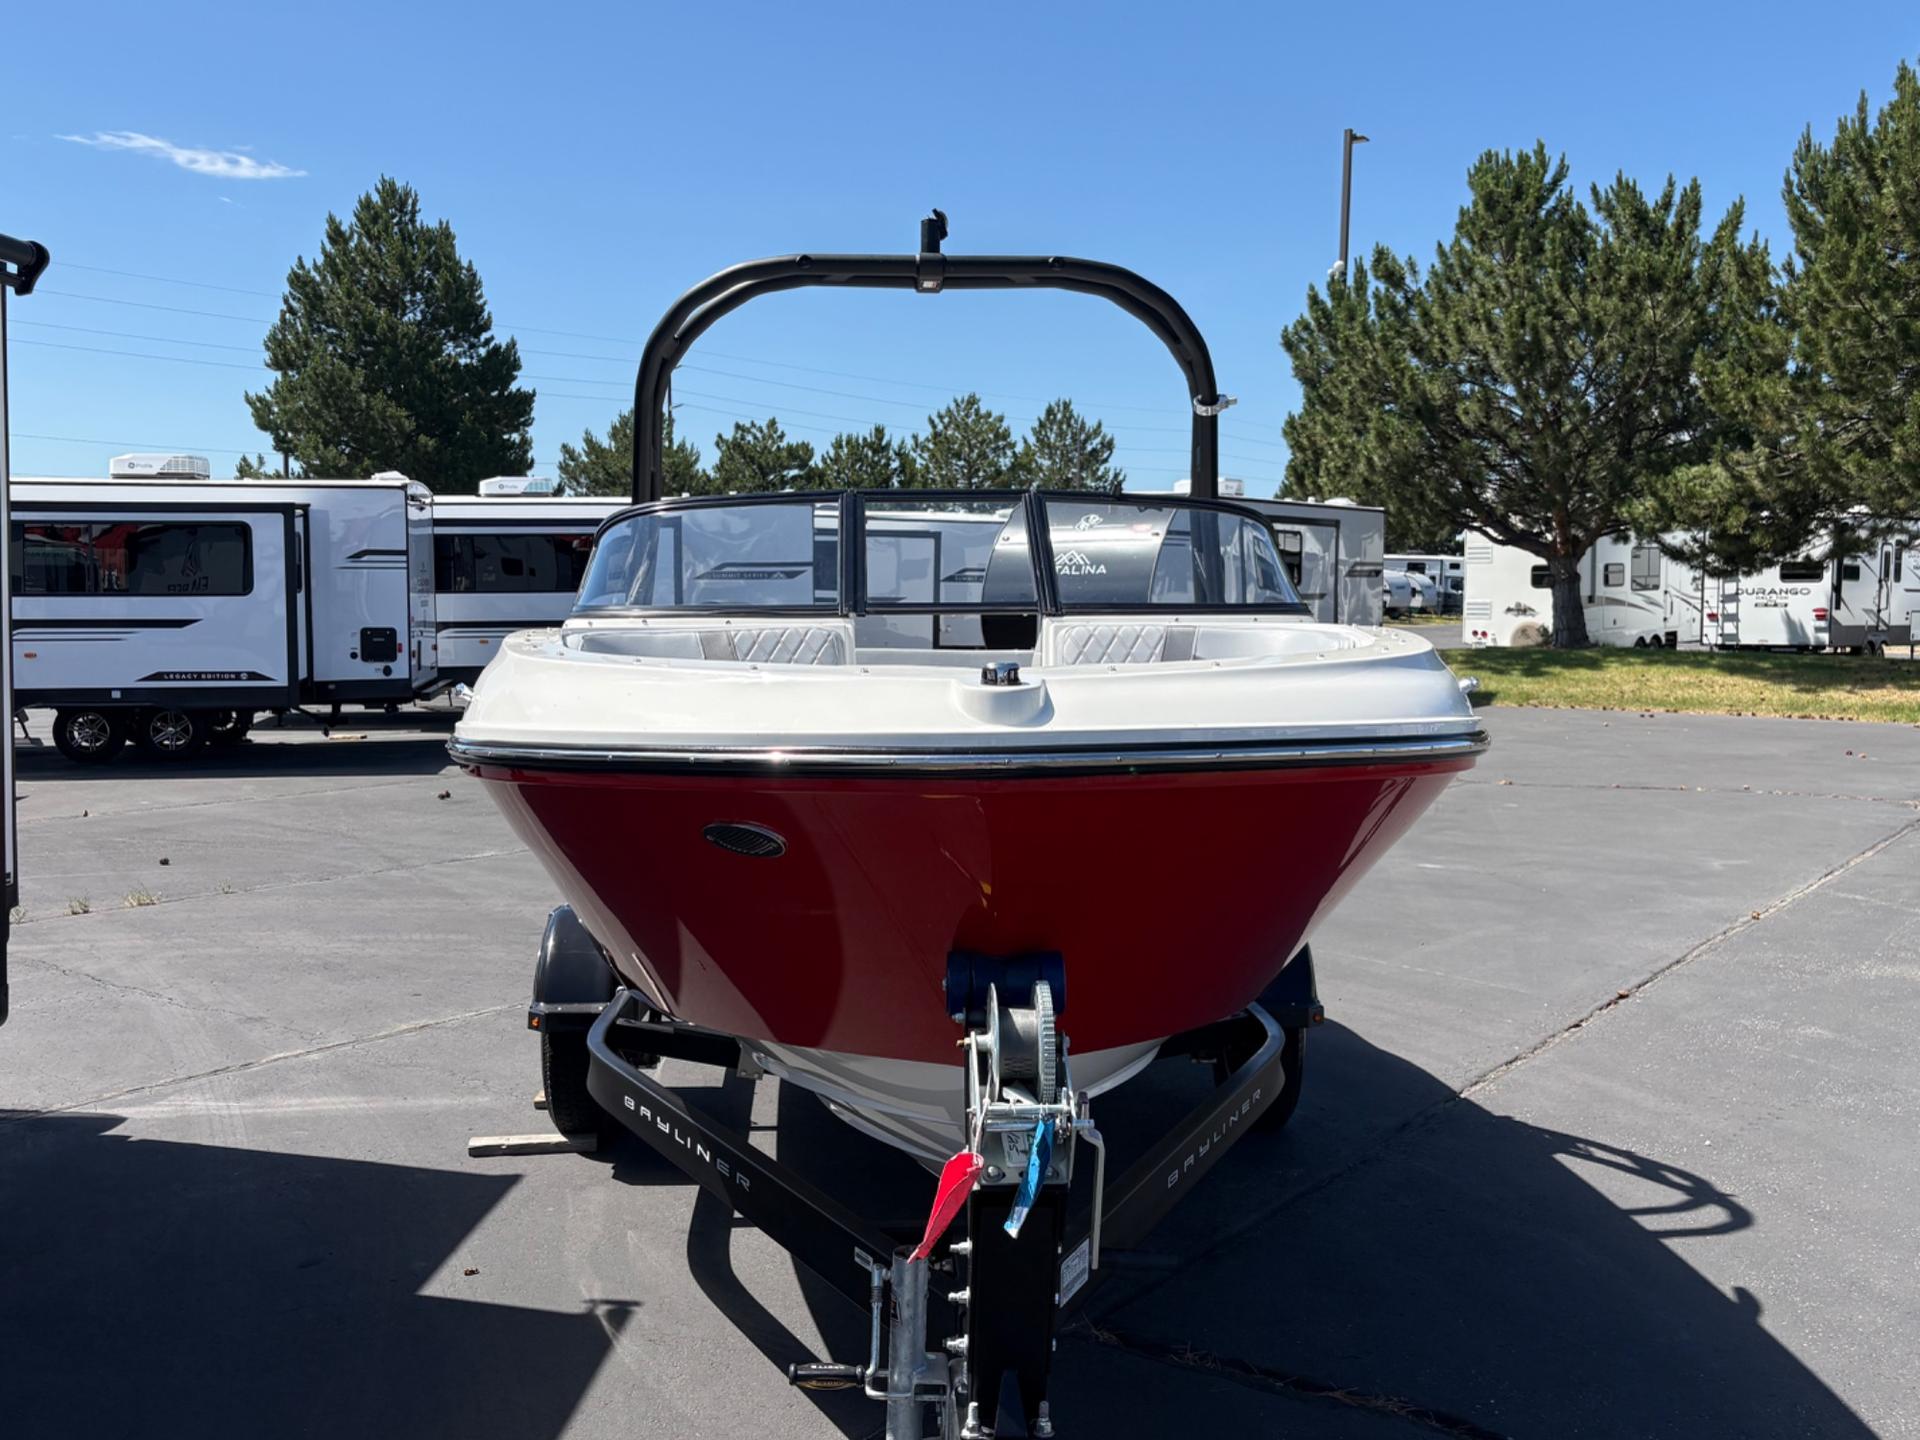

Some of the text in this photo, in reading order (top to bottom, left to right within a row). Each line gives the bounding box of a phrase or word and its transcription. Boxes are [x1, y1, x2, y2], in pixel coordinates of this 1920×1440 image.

[1055, 564, 1107, 575] TALINA
[1735, 587, 1811, 596] DURANGO
[624, 1095, 751, 1193] BAYLINER
[1167, 1088, 1261, 1190] BAYLINER
